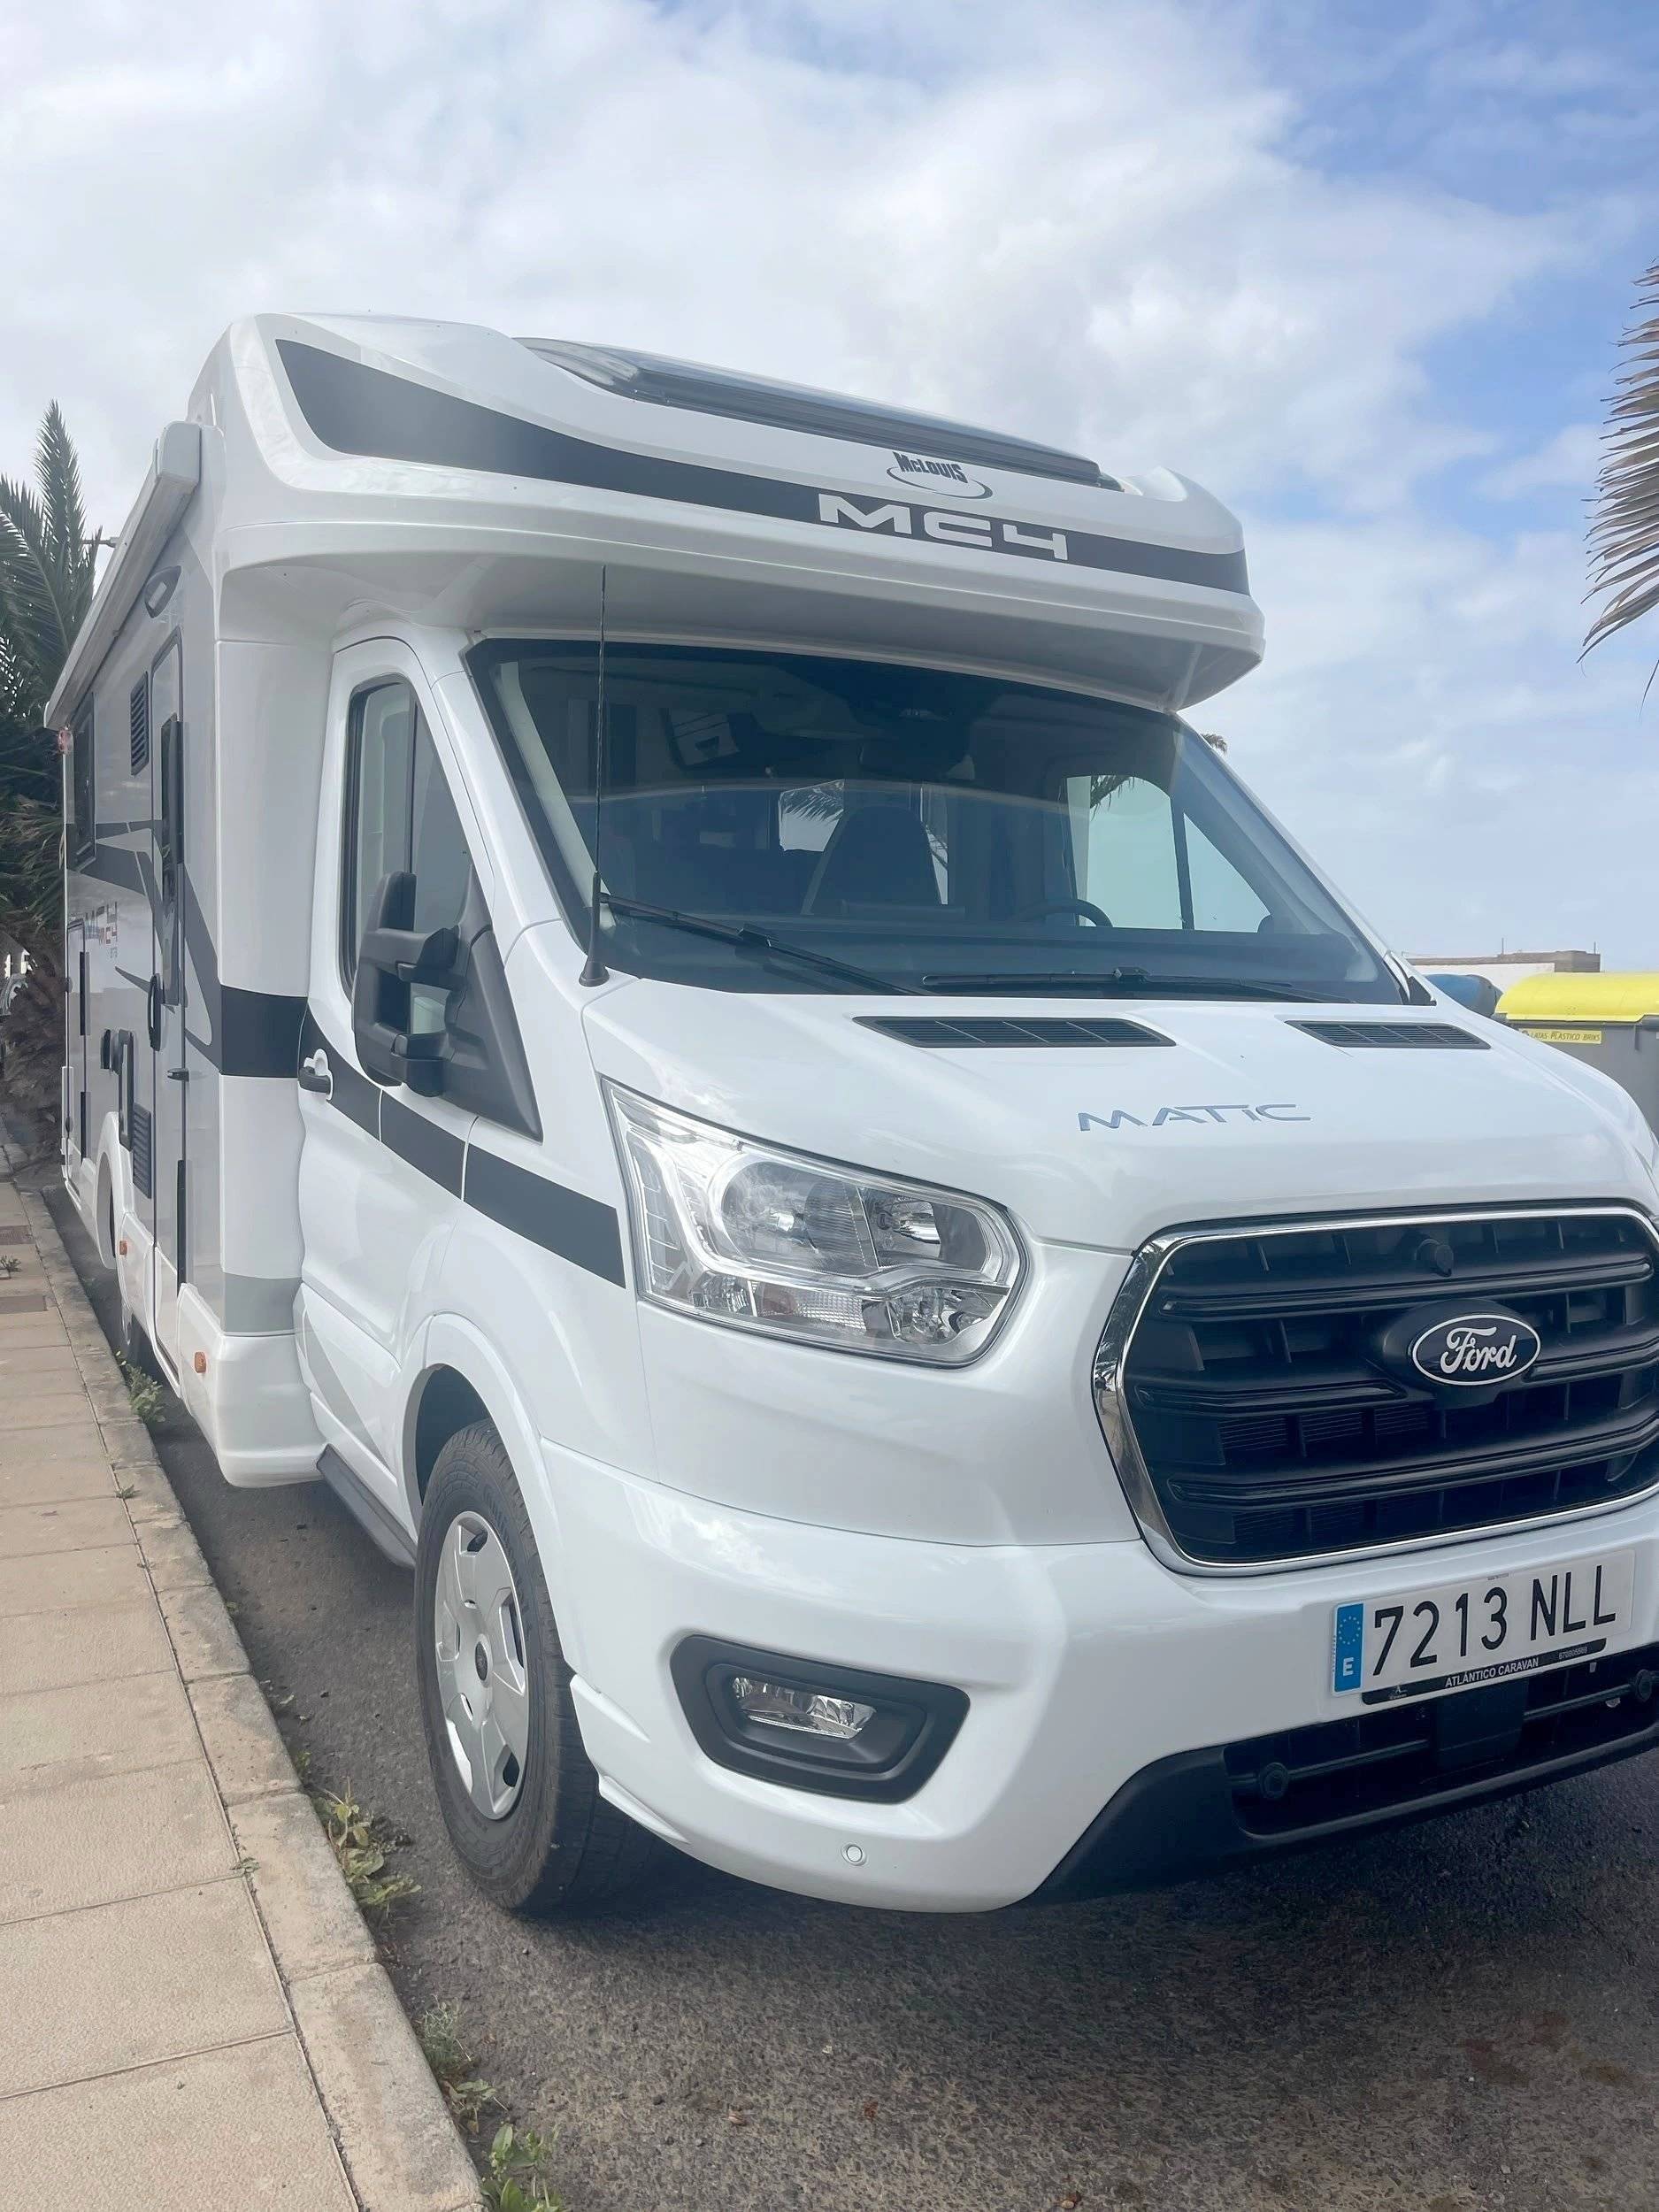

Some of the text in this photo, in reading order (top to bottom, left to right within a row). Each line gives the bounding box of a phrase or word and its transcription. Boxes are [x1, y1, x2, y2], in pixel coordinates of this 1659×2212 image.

[818, 492, 1069, 562] MC4
[1077, 1103, 1312, 1133] MATIC
[1440, 1326, 1518, 1374] Ford
[1372, 1564, 1617, 1677] 7213 NLL
[1342, 1656, 1355, 1677] E
[1445, 1667, 1496, 1688] ATLÁNTICO
[1498, 1657, 1540, 1676] CARAVAN
